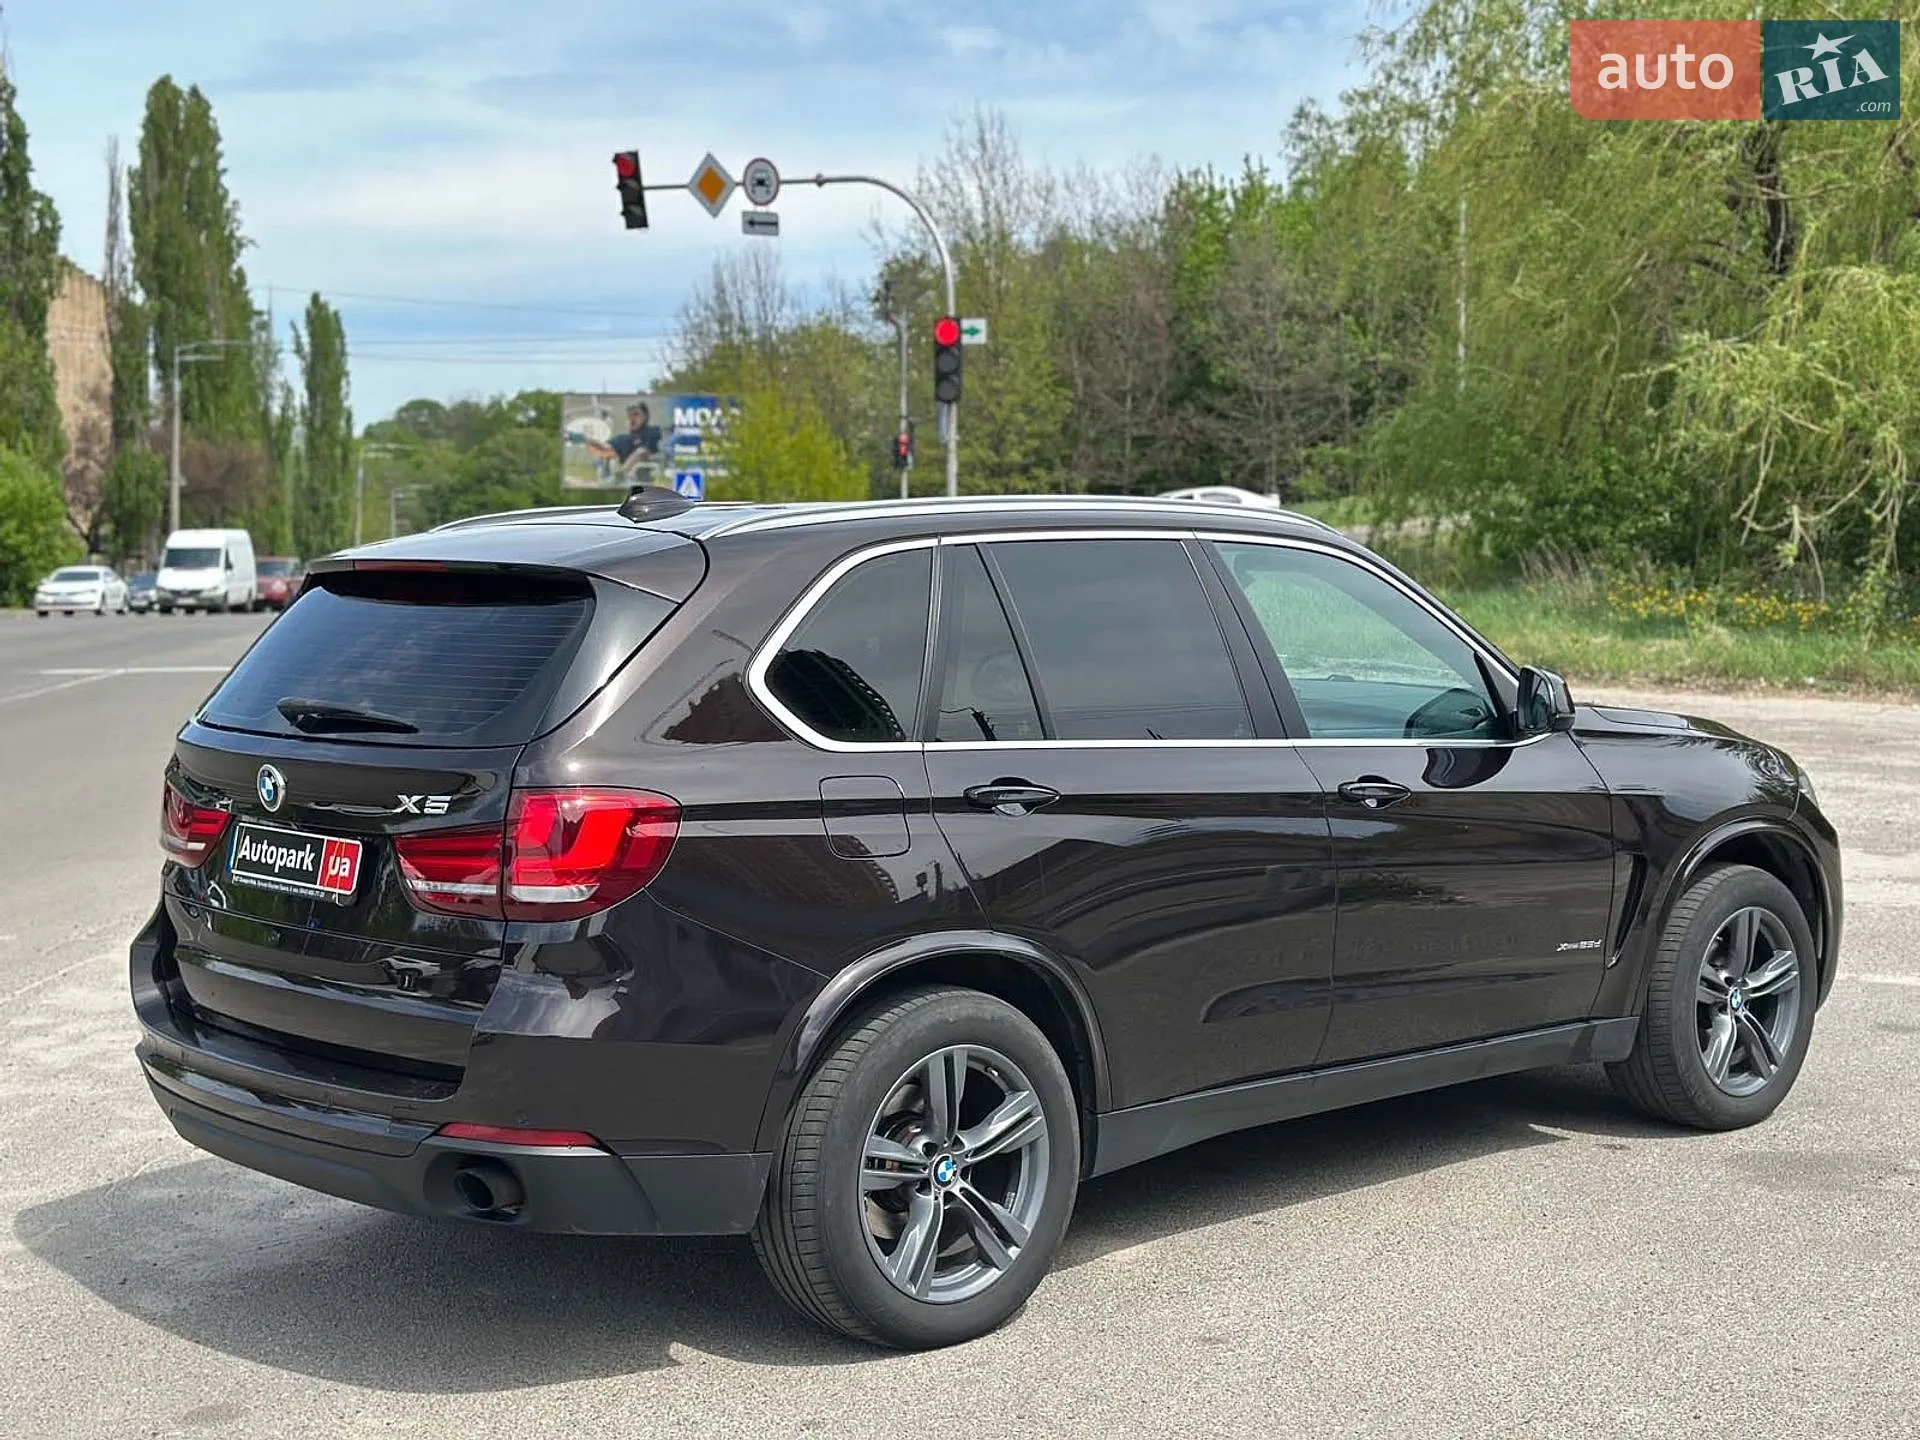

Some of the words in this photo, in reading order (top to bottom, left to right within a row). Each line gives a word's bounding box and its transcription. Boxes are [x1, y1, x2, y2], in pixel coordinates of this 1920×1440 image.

[392, 794, 453, 814] X5
[238, 835, 316, 873] Autopark
[328, 855, 351, 878] ua
